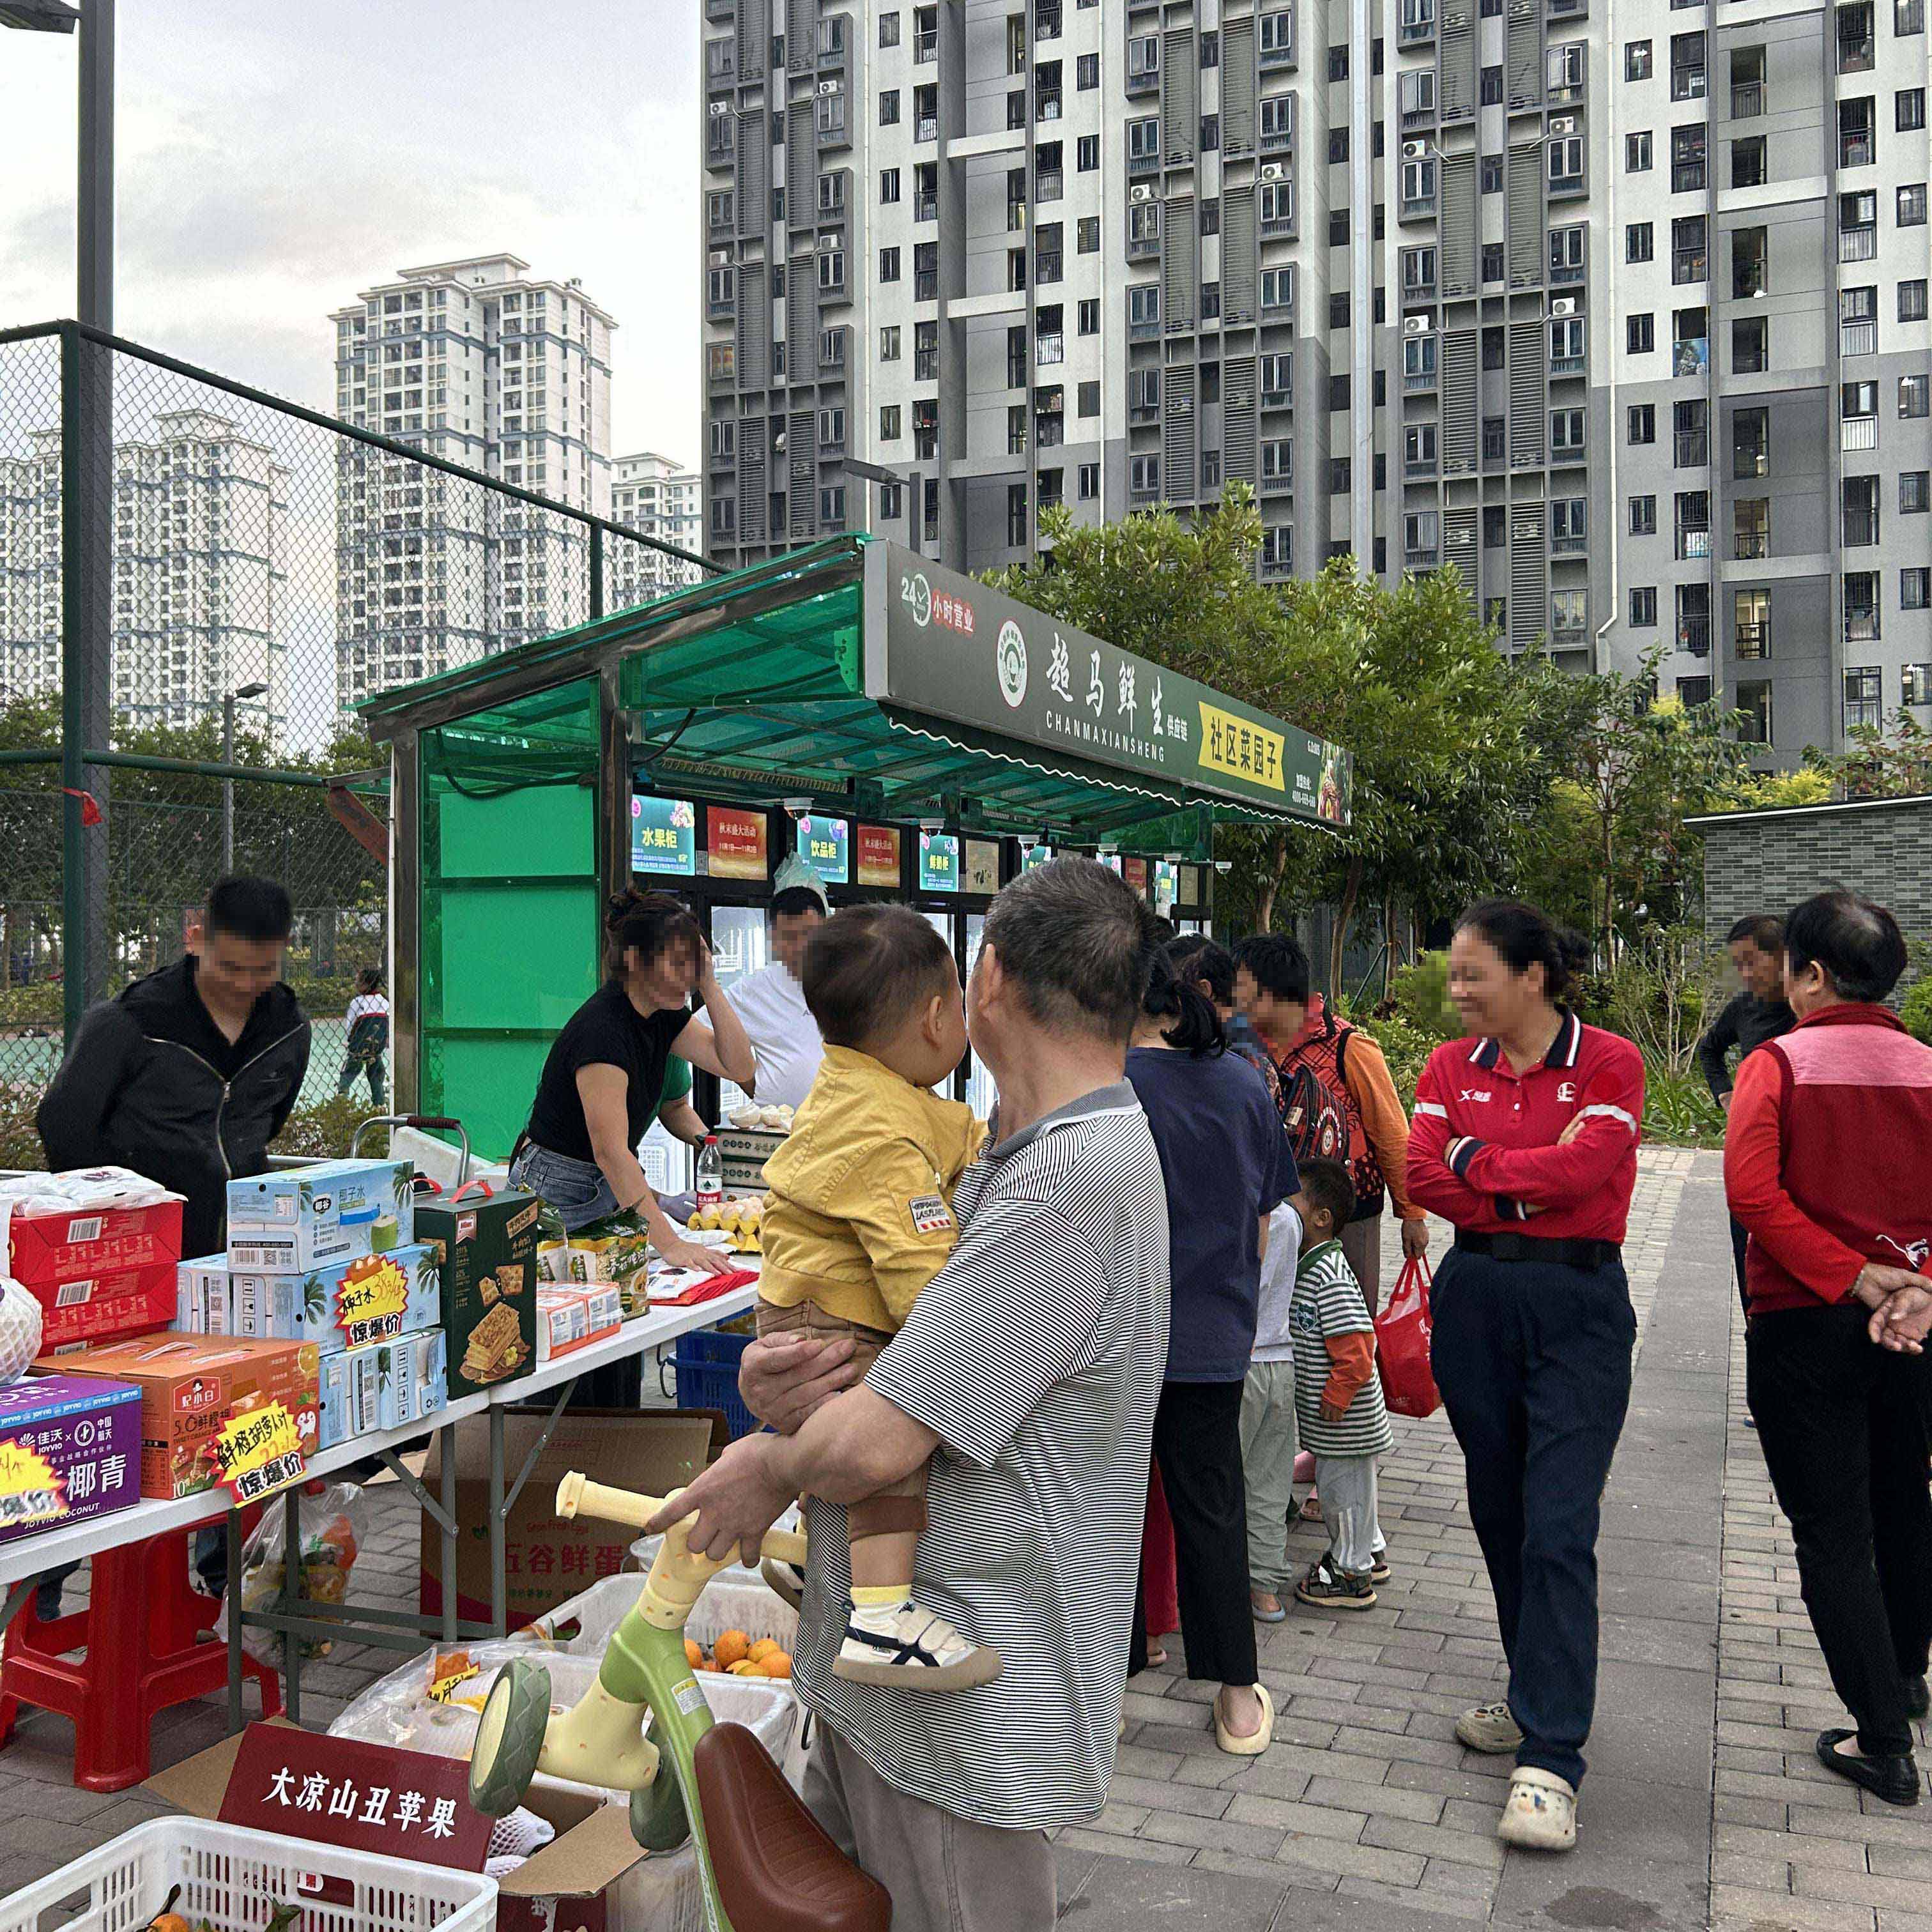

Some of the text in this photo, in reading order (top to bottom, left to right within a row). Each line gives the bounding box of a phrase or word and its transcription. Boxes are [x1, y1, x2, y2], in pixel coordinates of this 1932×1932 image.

[901, 576, 974, 632] 24 小时营业
[1046, 710, 1165, 762] CHANMAXIANSHENG
[1211, 716, 1276, 779] 社区菜园子
[641, 827, 678, 849] 水果柜
[810, 839, 837, 859] 饮品柜
[342, 1285, 376, 1315] 椰子水
[351, 1314, 400, 1344] 惊爆价
[93, 1395, 111, 1406] JOYVIO
[121, 1389, 139, 1400] JOYVIO
[33, 1409, 52, 1418] JOYVIO
[63, 1402, 82, 1412] JOYVIO
[1, 1415, 22, 1425] JOYVIO
[97, 1416, 112, 1427] 中国
[37, 1428, 63, 1446] 佳沃
[97, 1429, 112, 1442] 航天
[38, 1443, 63, 1454] JOYVIO
[56, 1453, 127, 1501] 椰青
[239, 1453, 302, 1498] 惊爆价
[172, 1481, 185, 1498] 10
[59, 1502, 100, 1520] COCONUT
[261, 1766, 457, 1839] 大凉山丑苹果
